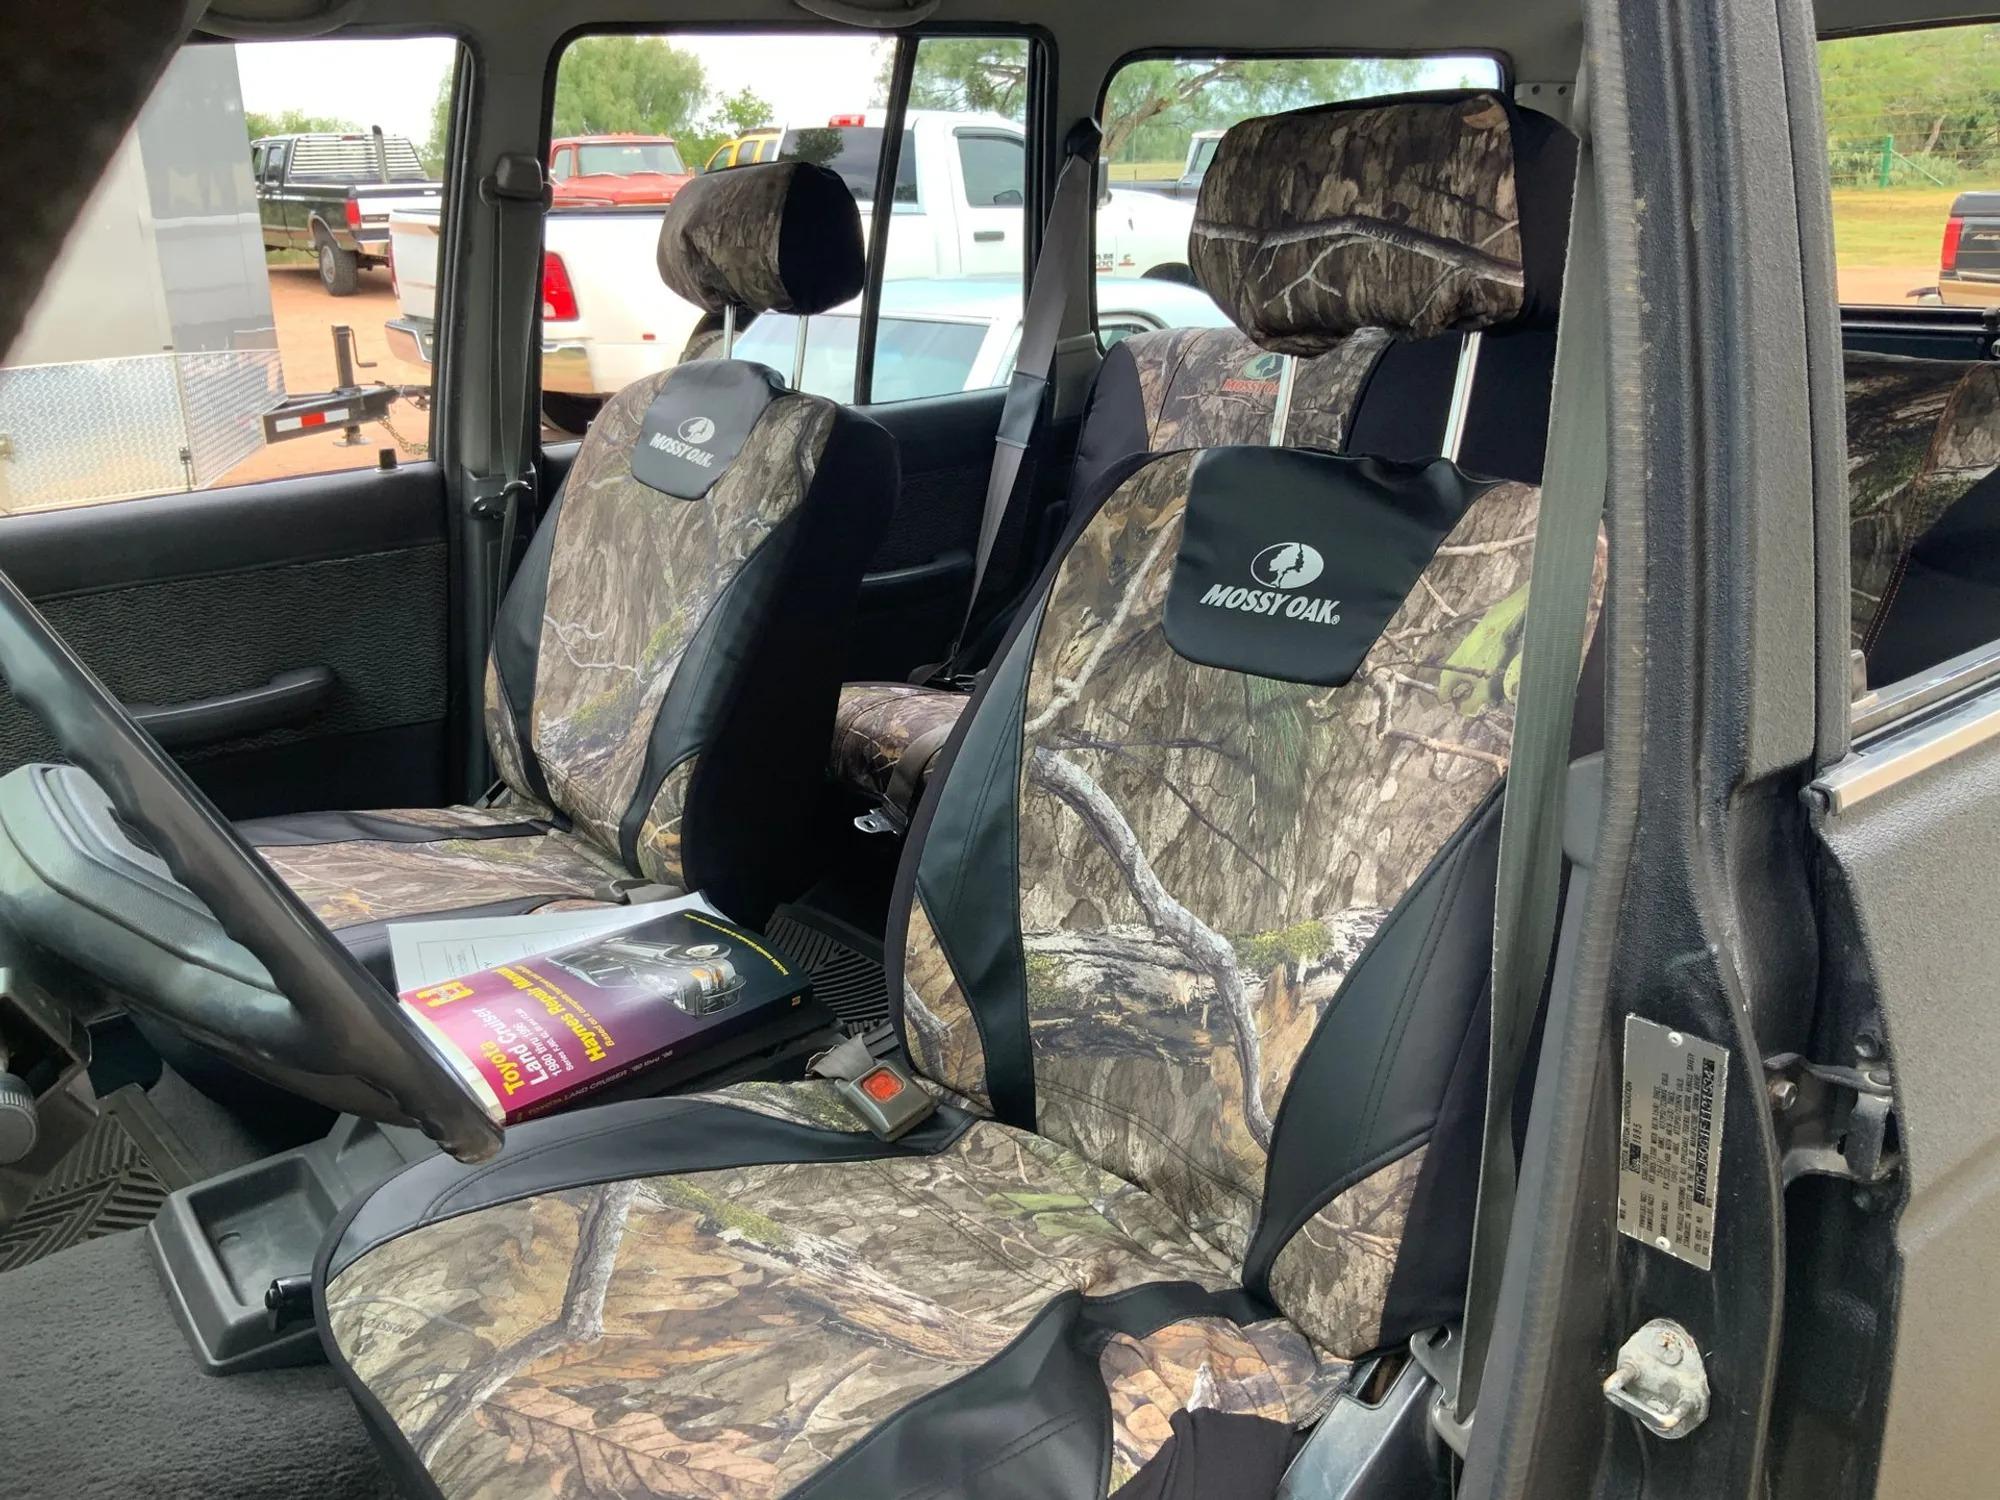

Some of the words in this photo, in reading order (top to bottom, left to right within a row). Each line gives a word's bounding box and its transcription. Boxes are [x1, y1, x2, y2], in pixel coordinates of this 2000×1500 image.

[1221, 378, 1266, 393] MOSSY
[649, 432, 692, 458] MOSSY
[1200, 583, 1291, 616] MOSSY
[527, 986, 567, 1016] Repair
[472, 1007, 517, 1044] Cruiser
[561, 1013, 607, 1062] Haynes
[530, 1037, 548, 1054] thru
[480, 1040, 526, 1096] Toyota
[507, 1043, 549, 1085] Land
[541, 1054, 562, 1077] 1980
[559, 1051, 574, 1071] Series
